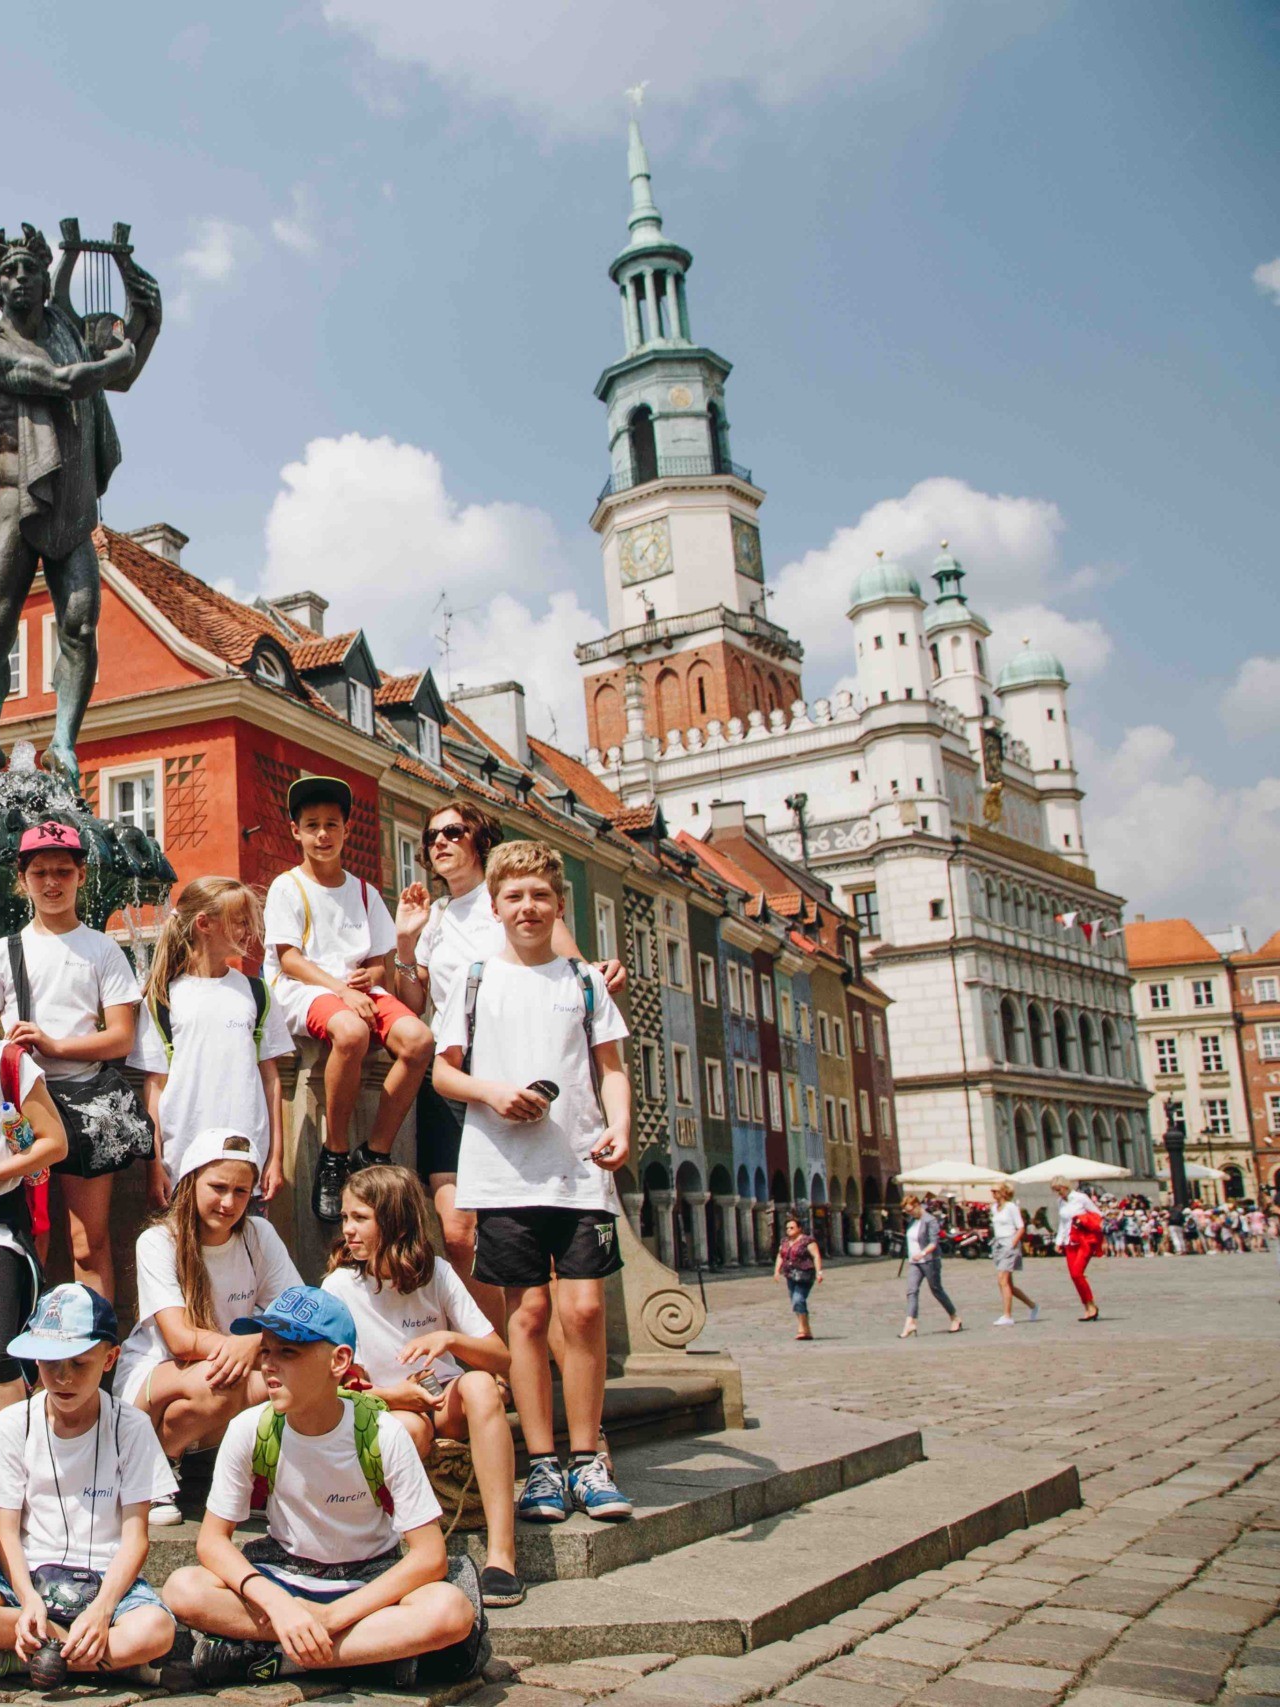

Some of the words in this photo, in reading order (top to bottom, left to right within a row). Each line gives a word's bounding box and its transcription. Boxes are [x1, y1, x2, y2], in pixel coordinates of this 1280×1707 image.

[37, 823, 67, 843] NY
[275, 1290, 319, 1324] 96
[82, 1486, 114, 1498] Kamil
[326, 1490, 367, 1503] Marcin
